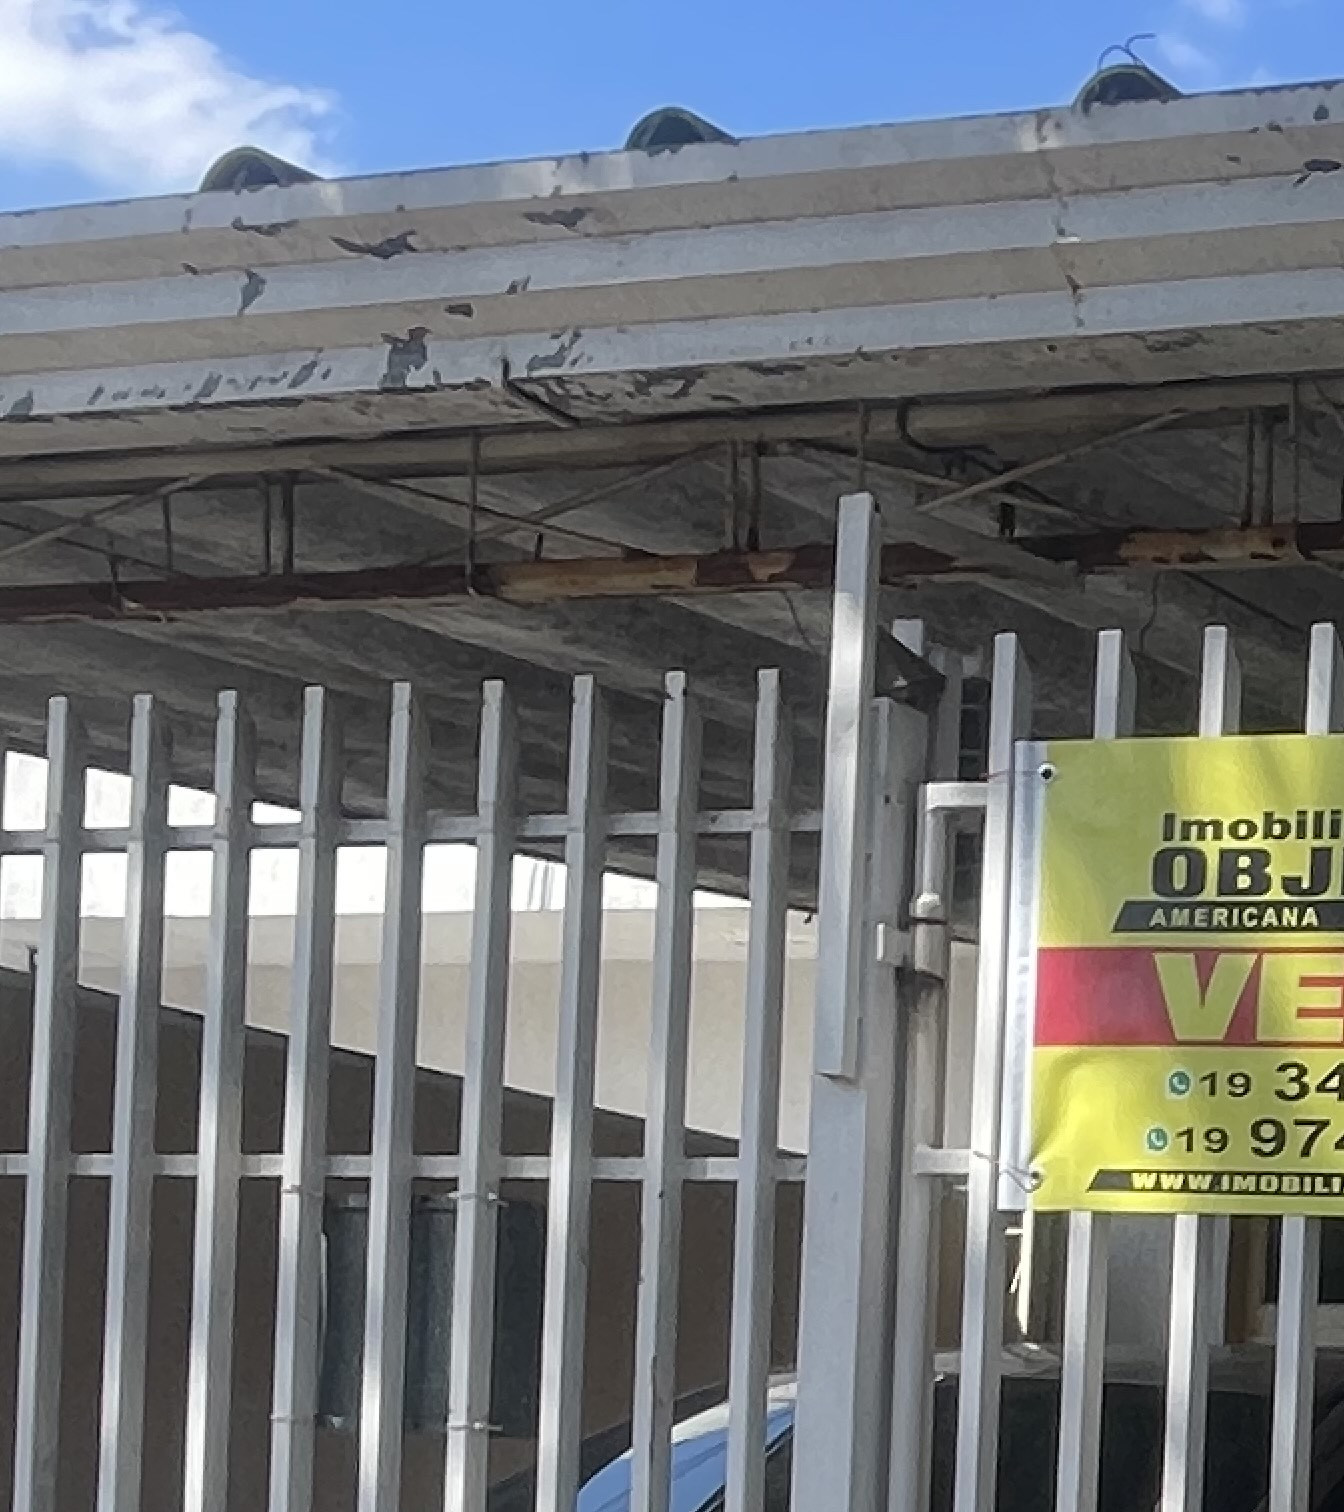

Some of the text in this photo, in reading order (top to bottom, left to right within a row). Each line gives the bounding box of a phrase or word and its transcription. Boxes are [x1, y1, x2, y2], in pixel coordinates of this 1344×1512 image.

[1149, 906, 1320, 929] AMERICANA
[1200, 1071, 1252, 1098] 19
[1175, 1127, 1229, 1154] 19
